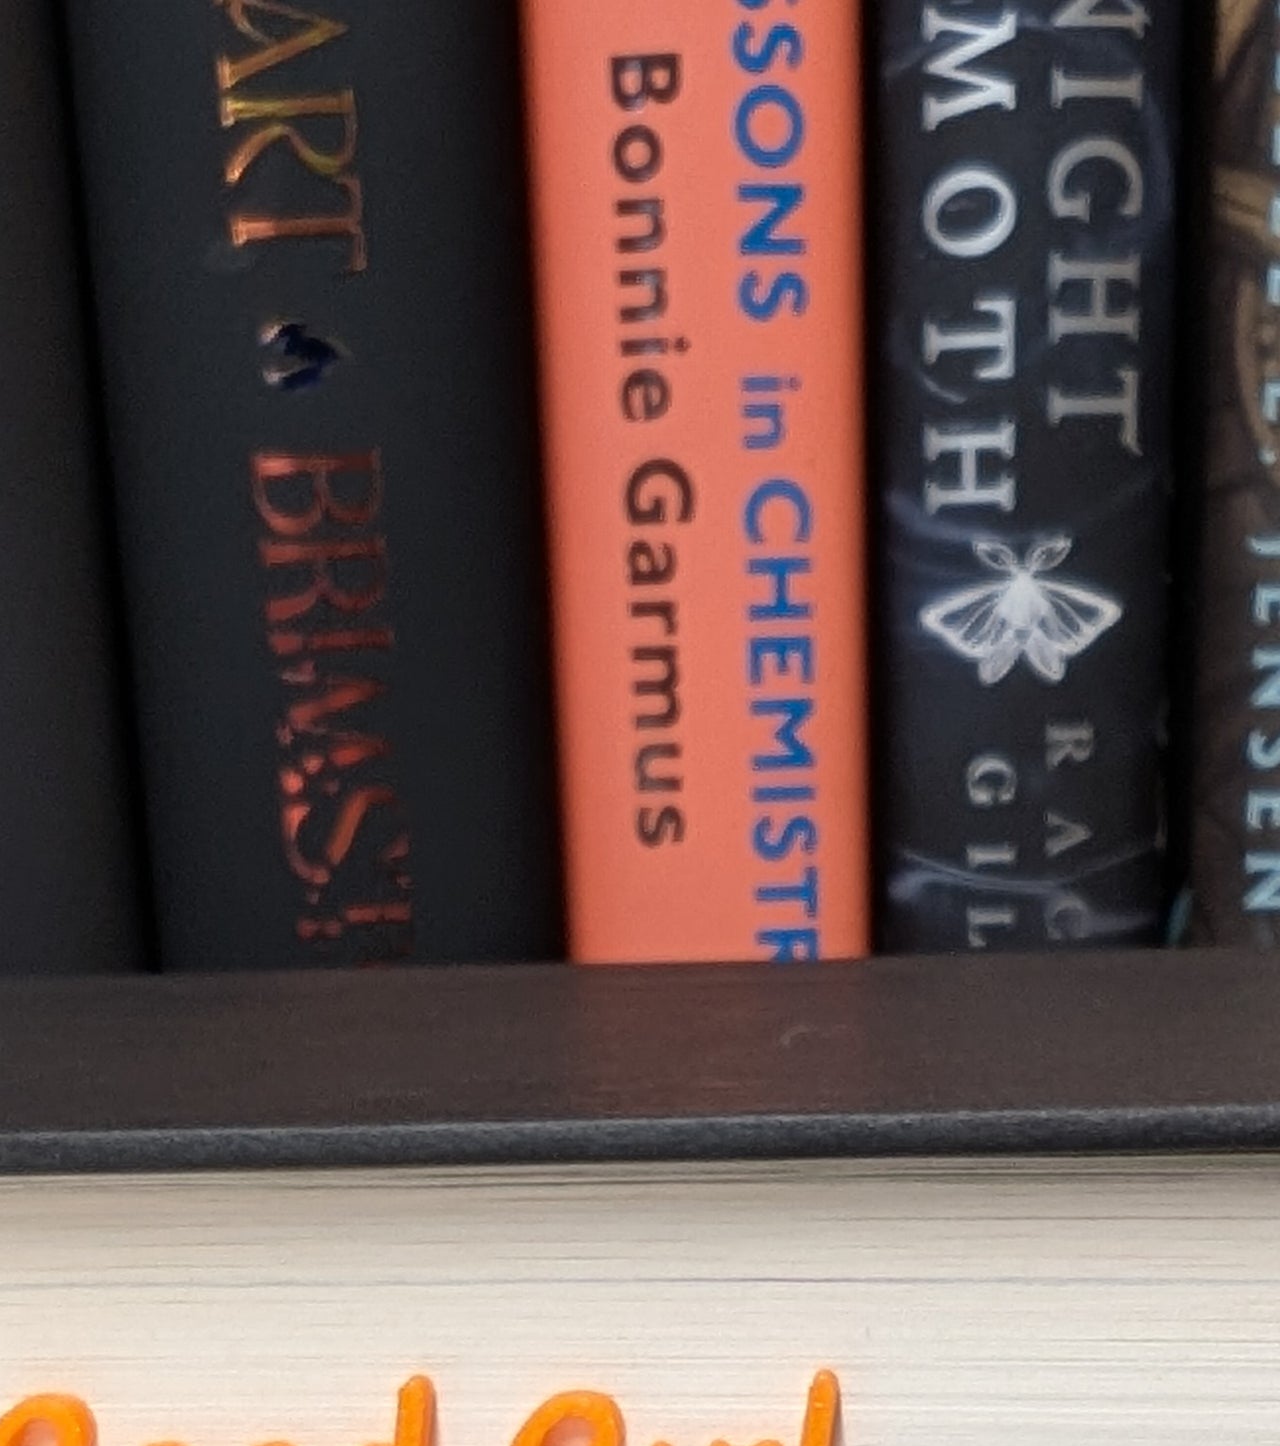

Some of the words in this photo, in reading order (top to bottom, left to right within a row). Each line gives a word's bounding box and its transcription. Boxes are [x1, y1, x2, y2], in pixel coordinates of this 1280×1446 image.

[608, 52, 691, 423] Bonnie
[730, 0, 808, 322] SONS
[922, 5, 1018, 516] MOTH
[740, 375, 802, 451] in
[625, 456, 697, 850] Garmus
